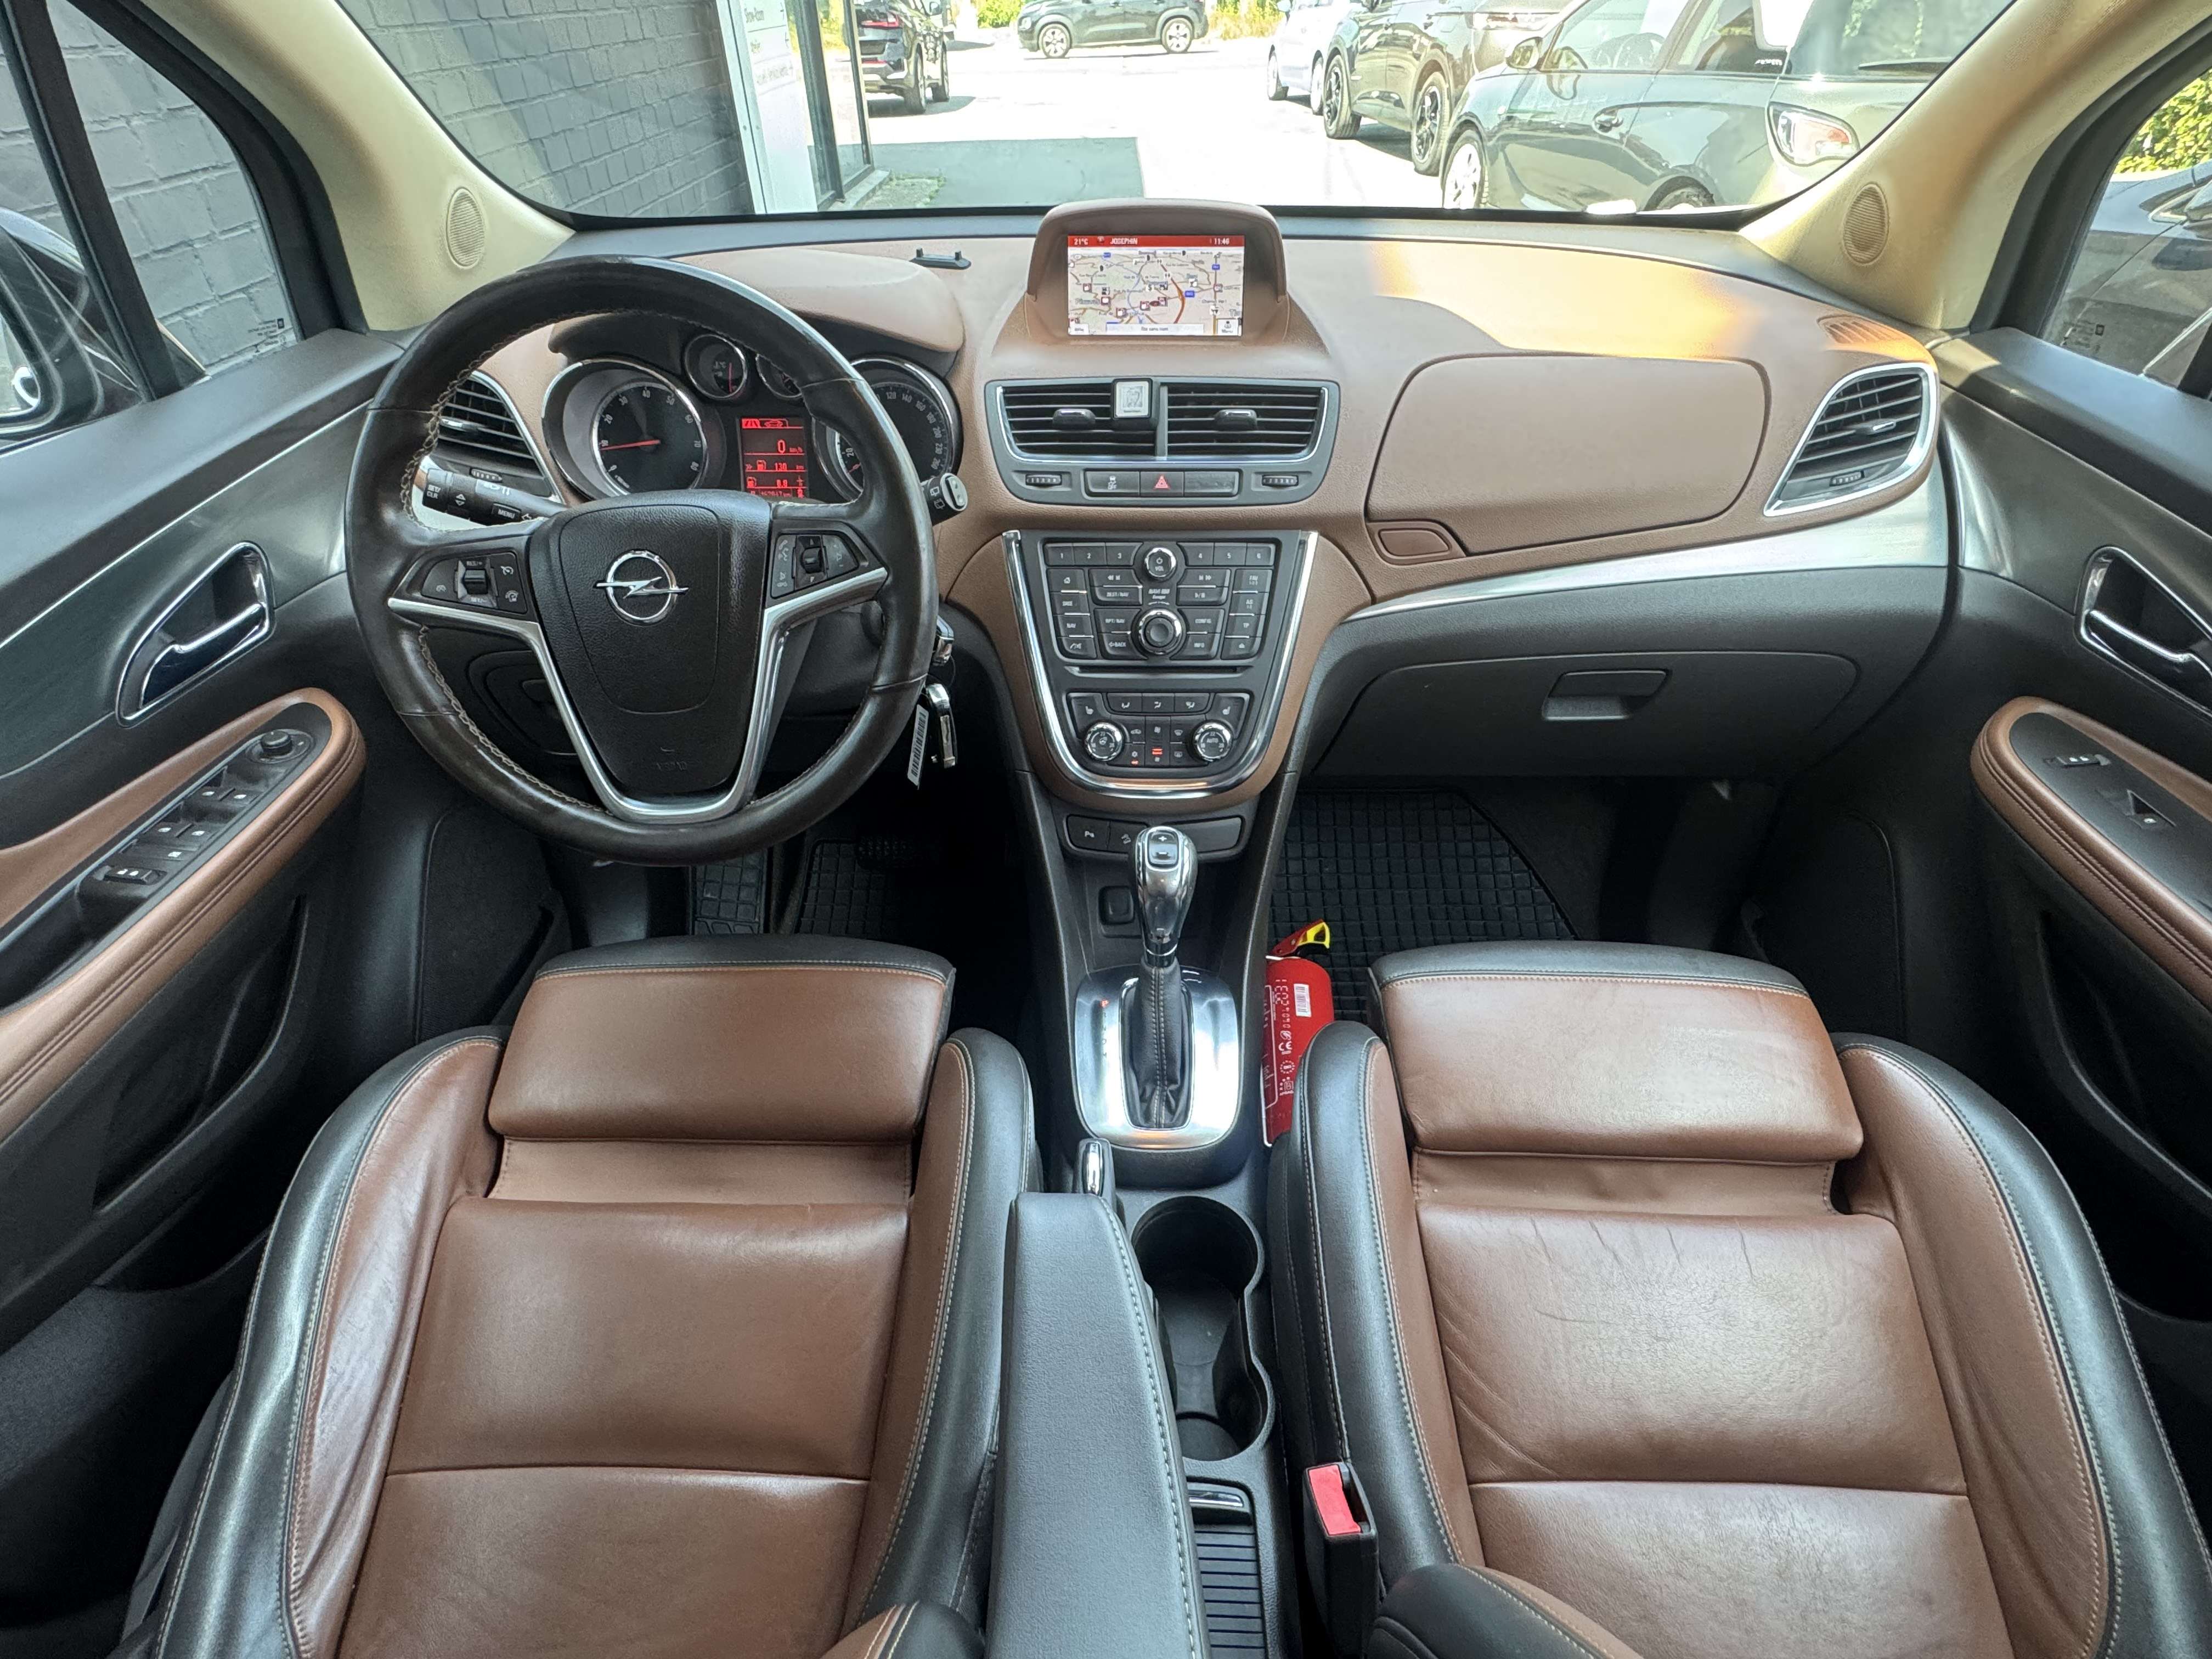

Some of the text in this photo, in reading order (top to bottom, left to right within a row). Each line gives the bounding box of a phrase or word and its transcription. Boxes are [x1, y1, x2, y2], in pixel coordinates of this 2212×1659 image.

[642, 390, 651, 398] 40
[777, 439, 786, 454] 0
[498, 509, 516, 519] MENU
